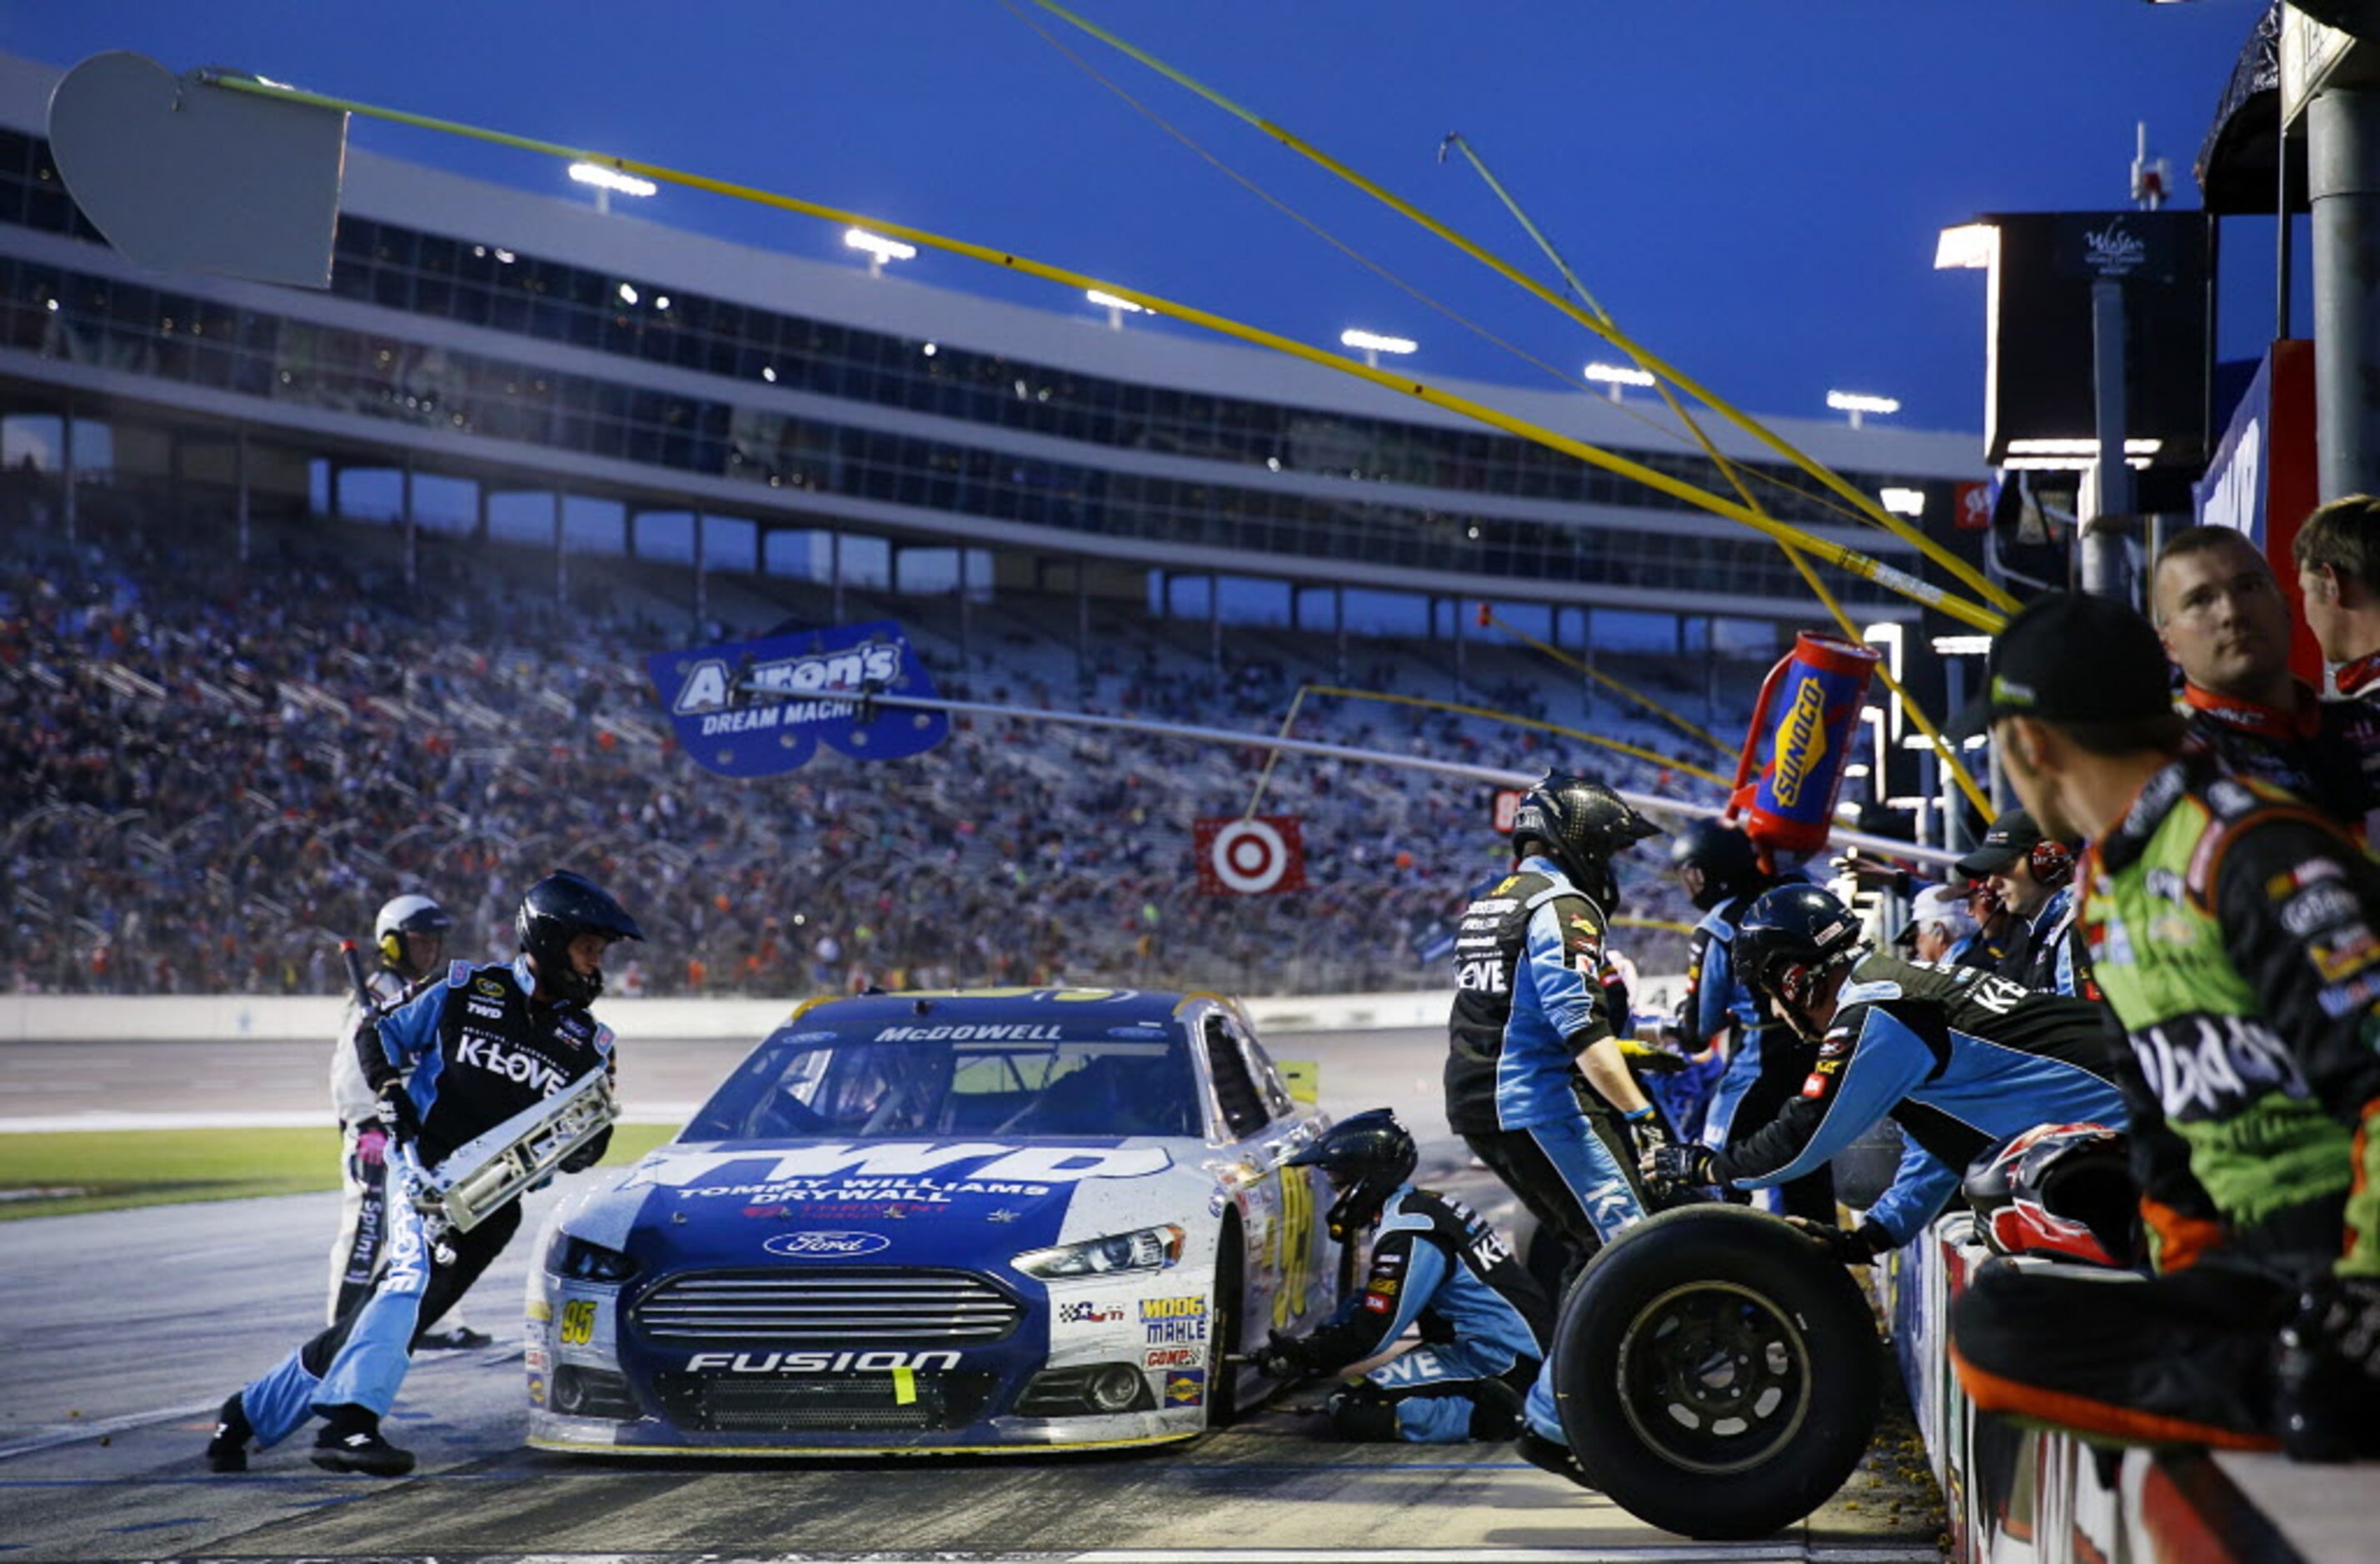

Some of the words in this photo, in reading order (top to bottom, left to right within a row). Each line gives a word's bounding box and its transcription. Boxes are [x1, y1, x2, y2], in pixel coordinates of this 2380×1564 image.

[701, 710, 779, 735] DREAM
[784, 697, 861, 724] MACHI
[1775, 684, 1824, 799] SUNOCO
[467, 1001, 503, 1019] TWD
[621, 1143, 1171, 1191] TWD
[679, 1178, 830, 1198] TOMMY
[840, 1177, 1049, 1196] WILLIAMS
[750, 1188, 952, 1204] DRYWALL
[353, 1200, 382, 1262] Sprint
[786, 1234, 867, 1251] Ford
[1139, 1295, 1207, 1322] MOOG
[561, 1299, 597, 1346] 95
[1147, 1320, 1205, 1343] MAHLE
[685, 1351, 962, 1372] FUSION
[1146, 1349, 1191, 1367] COMP
